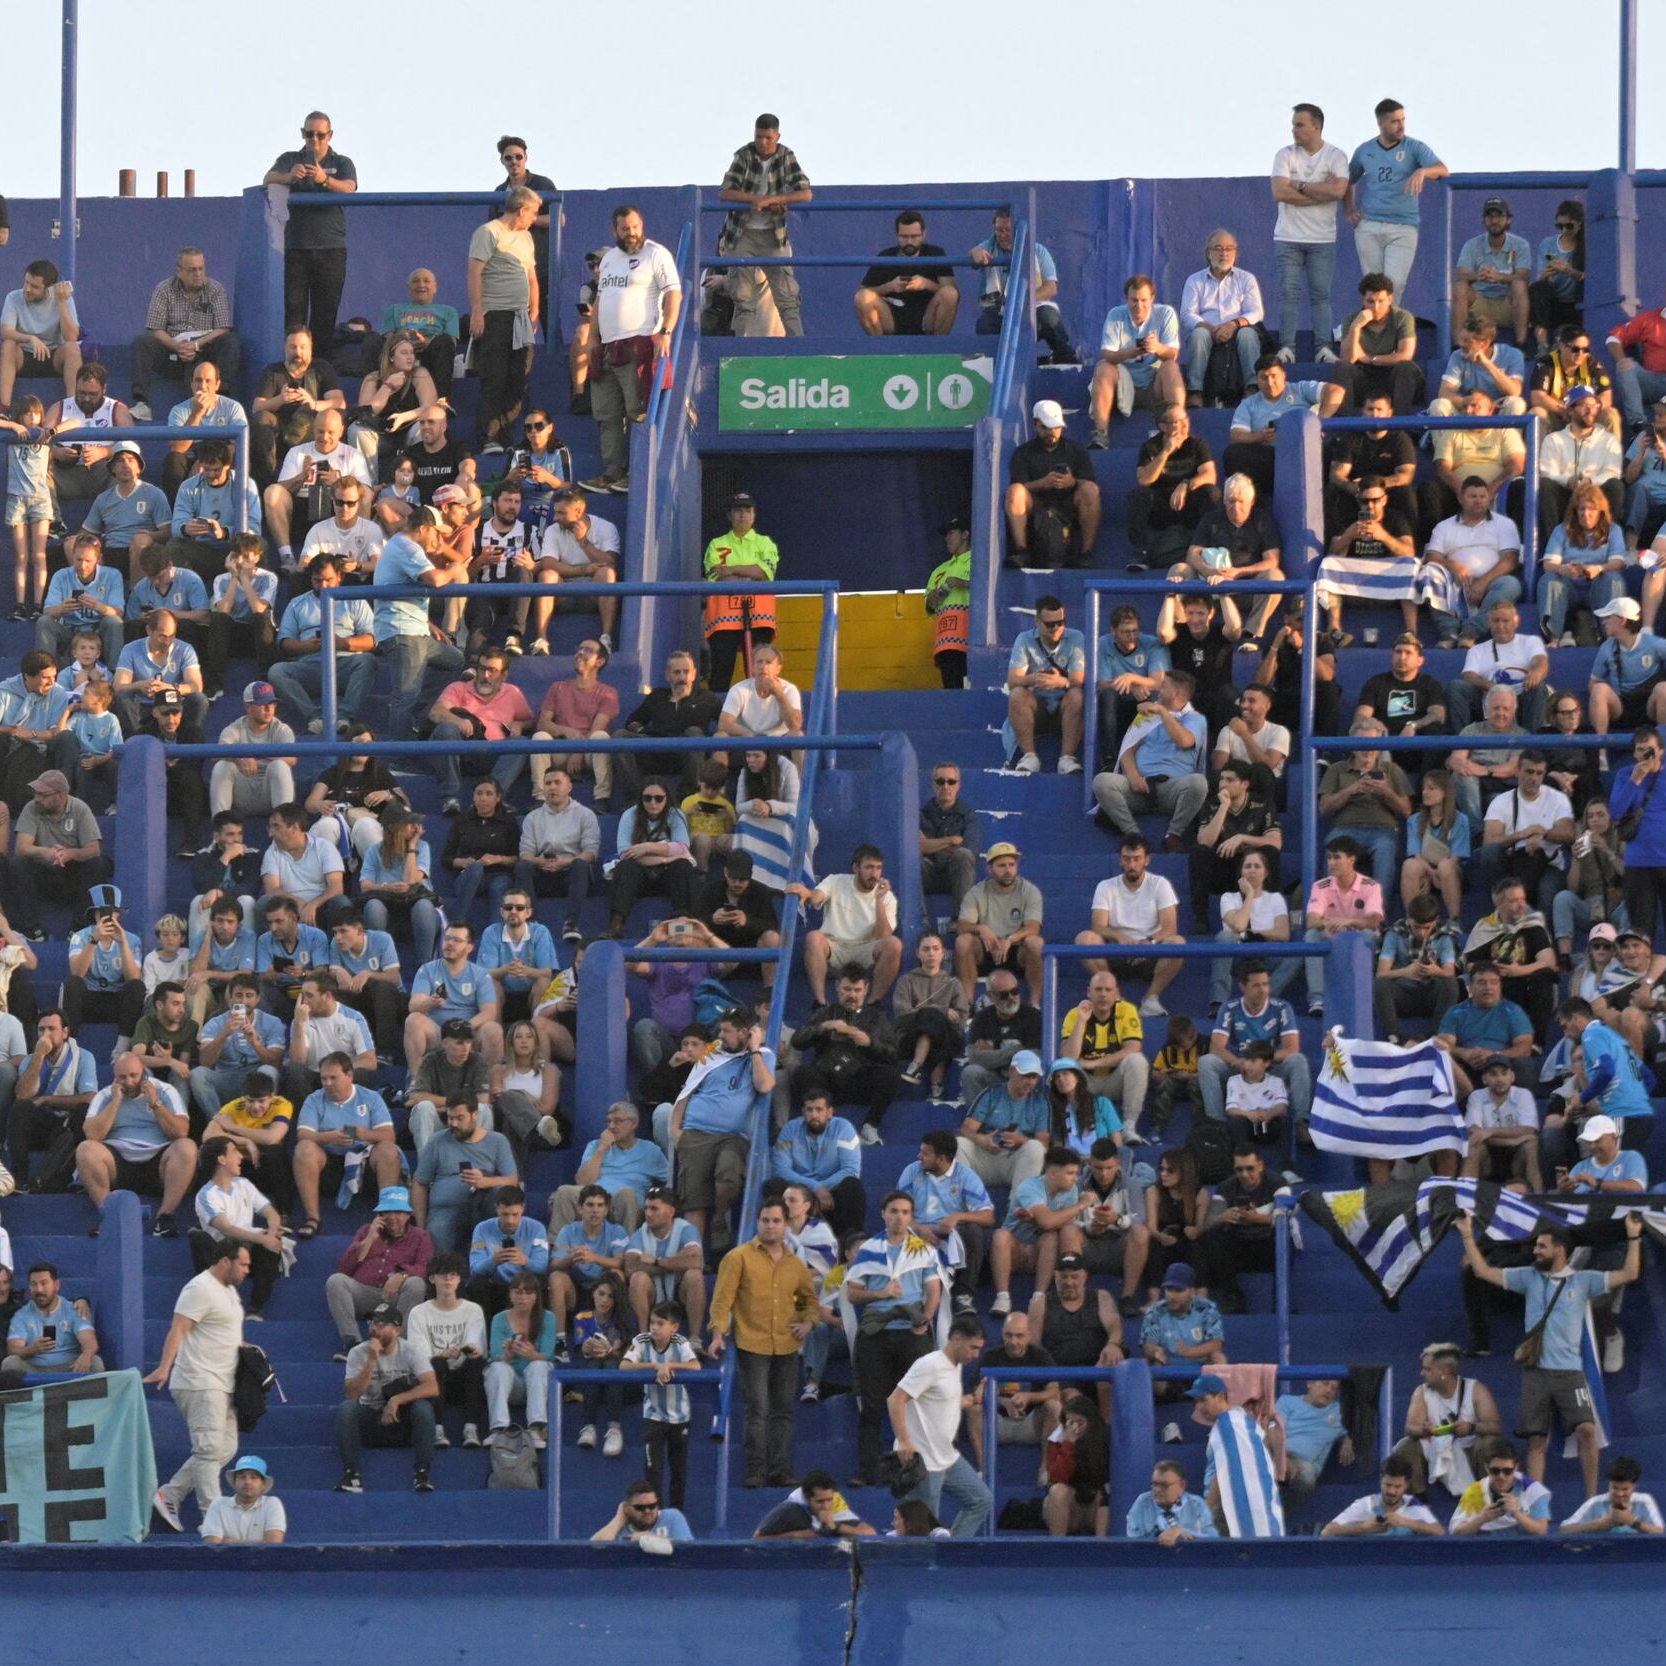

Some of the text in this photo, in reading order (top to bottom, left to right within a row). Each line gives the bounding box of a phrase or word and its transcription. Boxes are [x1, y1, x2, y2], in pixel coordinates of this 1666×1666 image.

[1379, 167, 1393, 183] 22
[739, 378, 850, 410] Salida
[926, 1196, 939, 1216] 2
